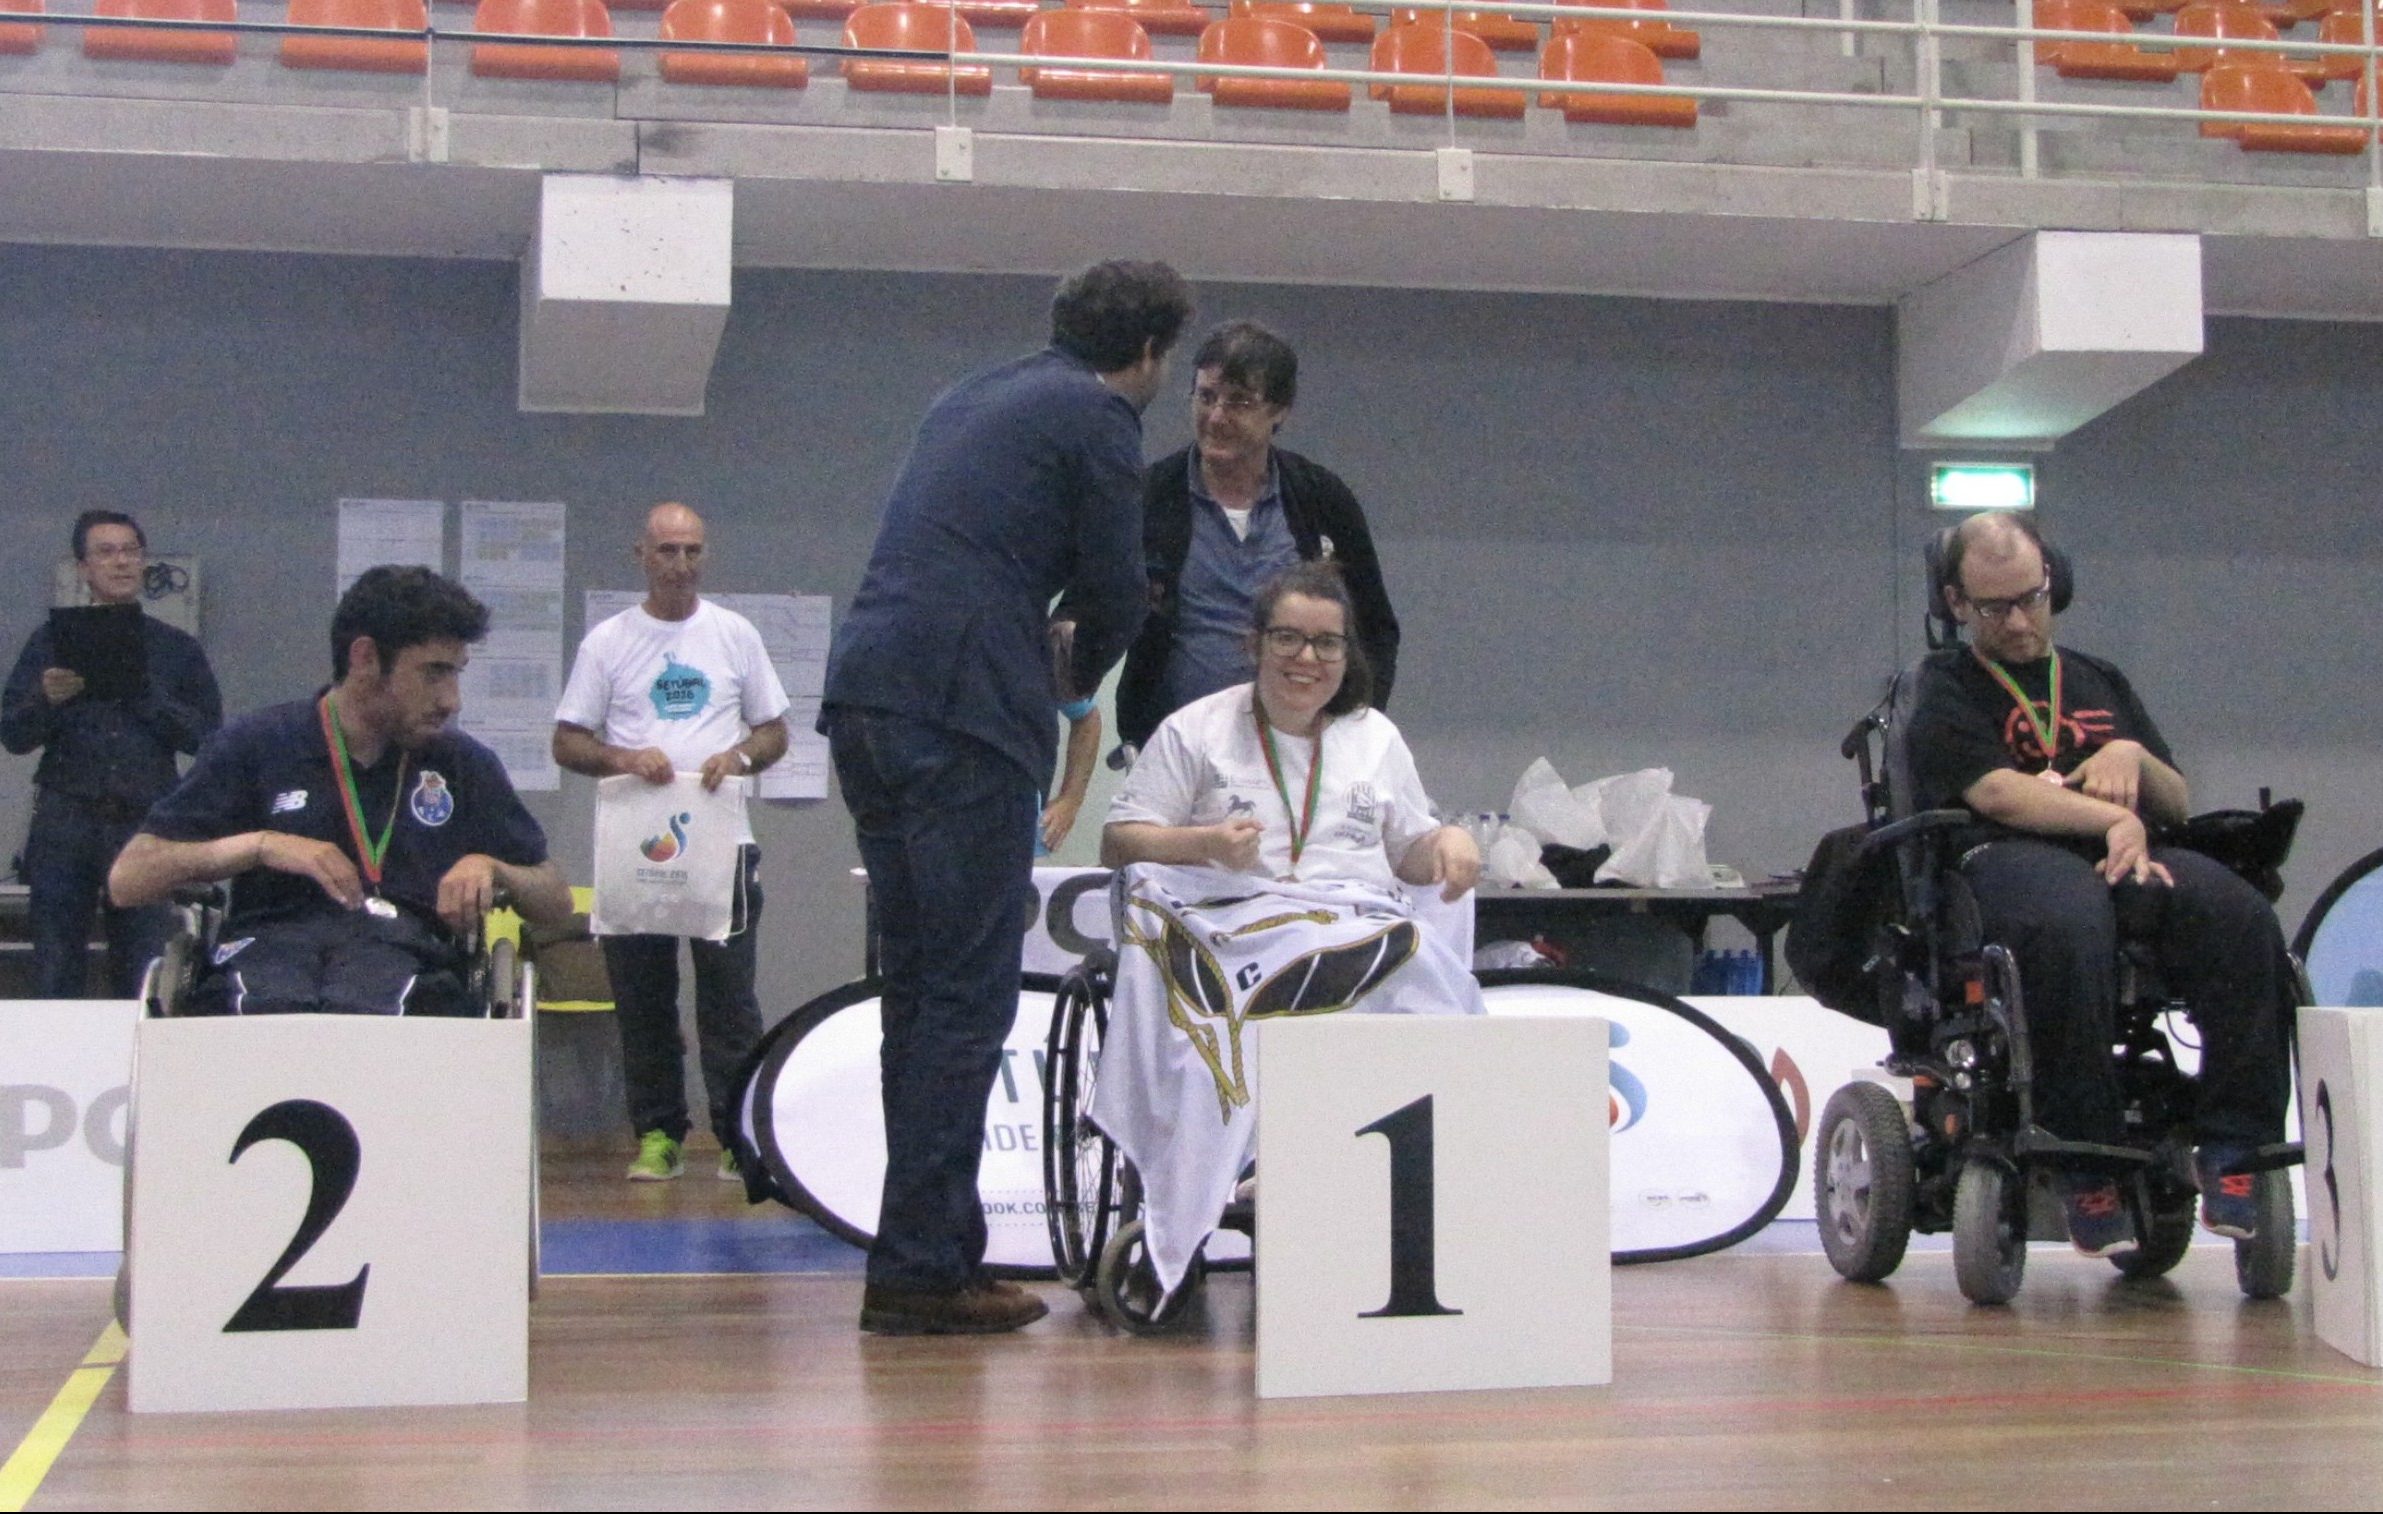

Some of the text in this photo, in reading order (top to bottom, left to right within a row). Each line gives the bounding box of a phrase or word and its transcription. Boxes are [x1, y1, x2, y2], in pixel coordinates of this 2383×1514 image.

[222, 1099, 370, 1334] 2
[1355, 1095, 1463, 1318] 1
[2315, 1078, 2341, 1281] 3
